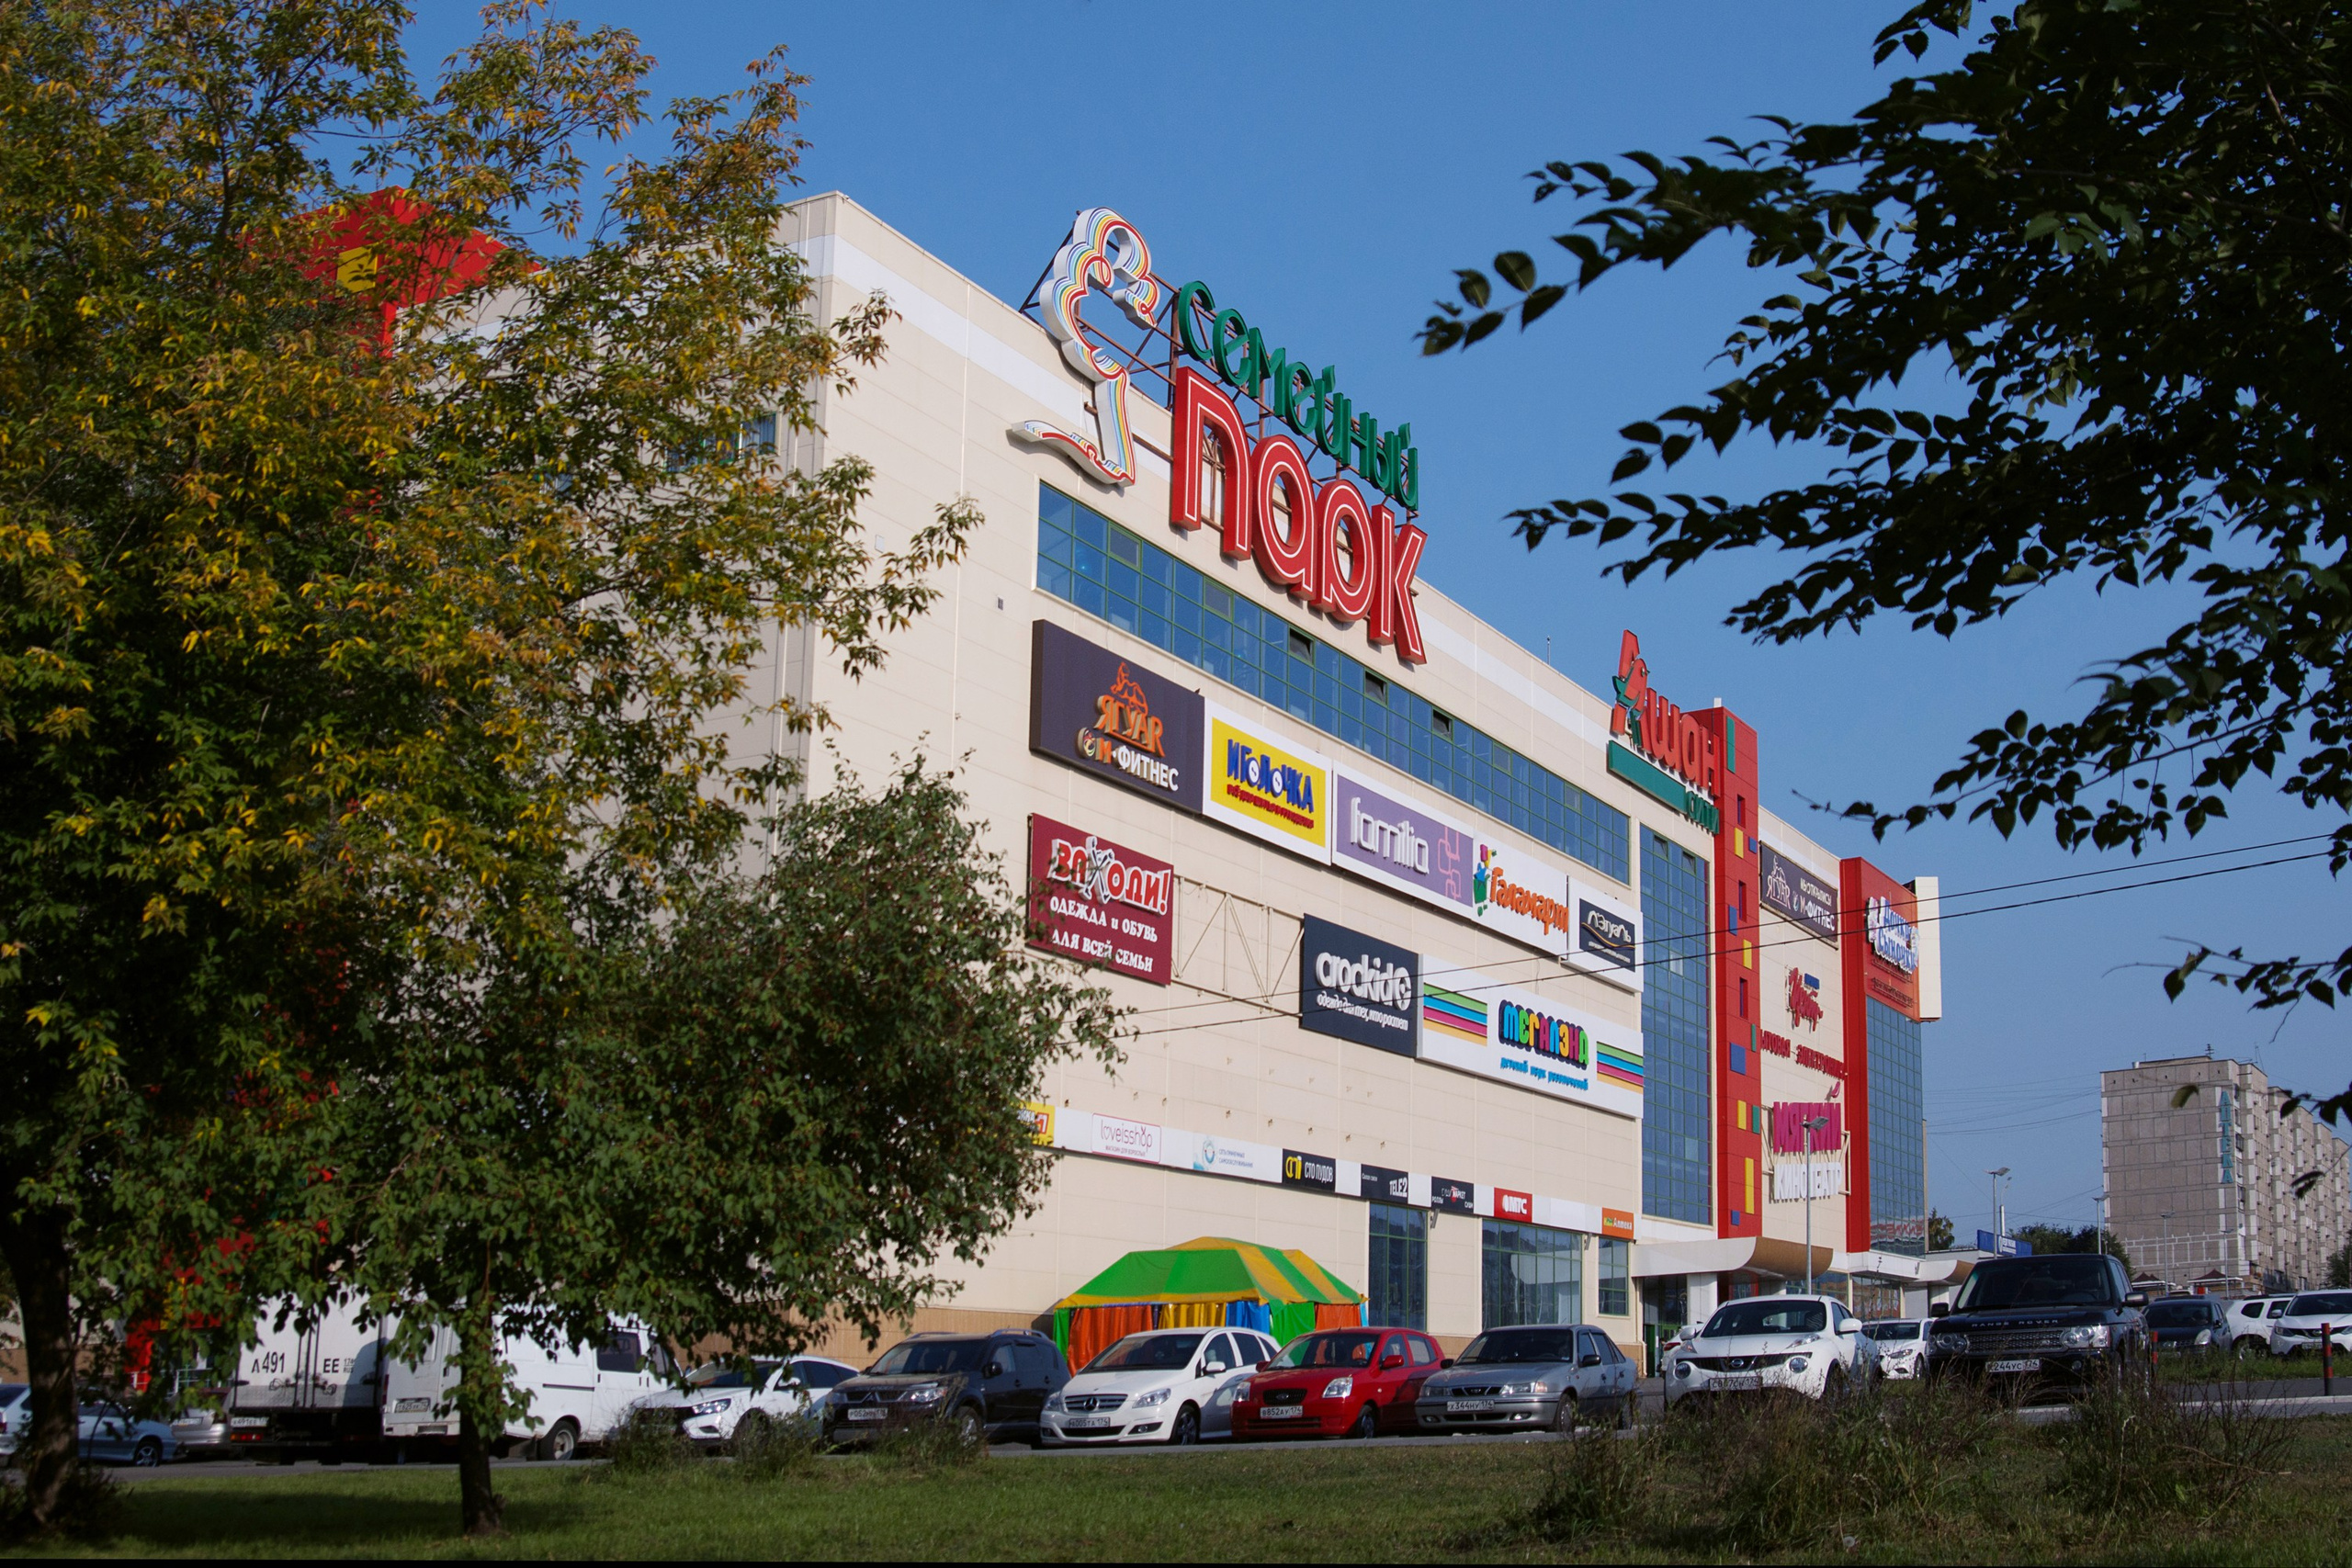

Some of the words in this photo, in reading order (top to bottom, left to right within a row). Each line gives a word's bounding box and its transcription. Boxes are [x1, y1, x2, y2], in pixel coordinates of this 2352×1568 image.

[1350, 796, 1429, 874] familia
[1050, 897, 1107, 926] ОДЕЖДА
[1122, 919, 1159, 942] ОБУВЬ
[1052, 929, 1080, 950] ДЛЯ
[1082, 940, 1114, 959] ВСЕЙ
[1115, 949, 1153, 973] СЕМЬИ
[2219, 1090, 2233, 1184] АПТЕКА
[1305, 1161, 1315, 1179] СТО
[1315, 1164, 1334, 1183] ПУДОВ
[1389, 1177, 1408, 1198] TELE2
[1510, 1196, 1527, 1214] МТС
[1987, 1361, 2022, 1371] 244УС
